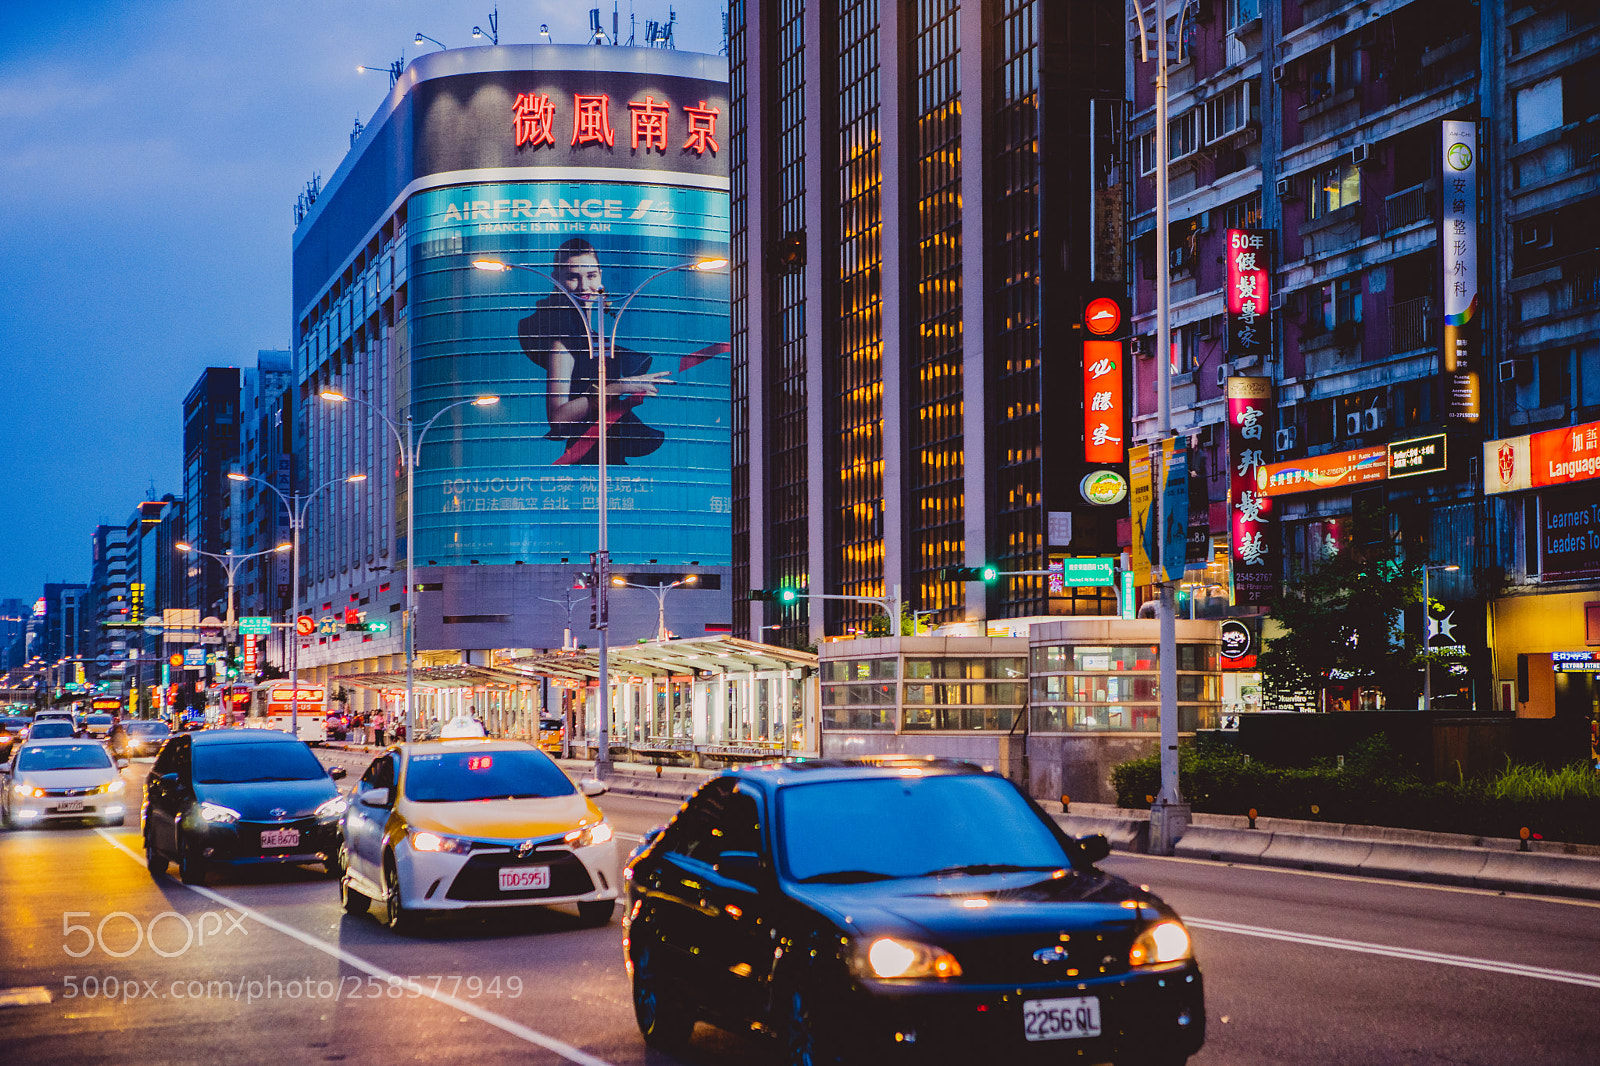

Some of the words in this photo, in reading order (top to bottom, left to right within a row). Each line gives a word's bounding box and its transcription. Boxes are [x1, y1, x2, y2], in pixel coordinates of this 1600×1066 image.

[512, 92, 721, 154] 微風南京
[443, 198, 623, 223] AIRFRANCE
[479, 223, 527, 233] FRANCE
[530, 223, 541, 232] IS
[545, 223, 559, 232] IN
[563, 223, 586, 232] THE
[589, 223, 611, 232] AIR
[1231, 234, 1264, 250] 50年
[1088, 358, 1121, 446] 必勝客
[1549, 457, 1600, 479] Language
[443, 477, 533, 495] BONJOUR
[1547, 509, 1589, 529] Learners
[1547, 536, 1586, 554] Leaders
[1588, 530, 1600, 550] To
[1236, 573, 1273, 582] 2545-2767
[1248, 591, 1261, 601] 2F
